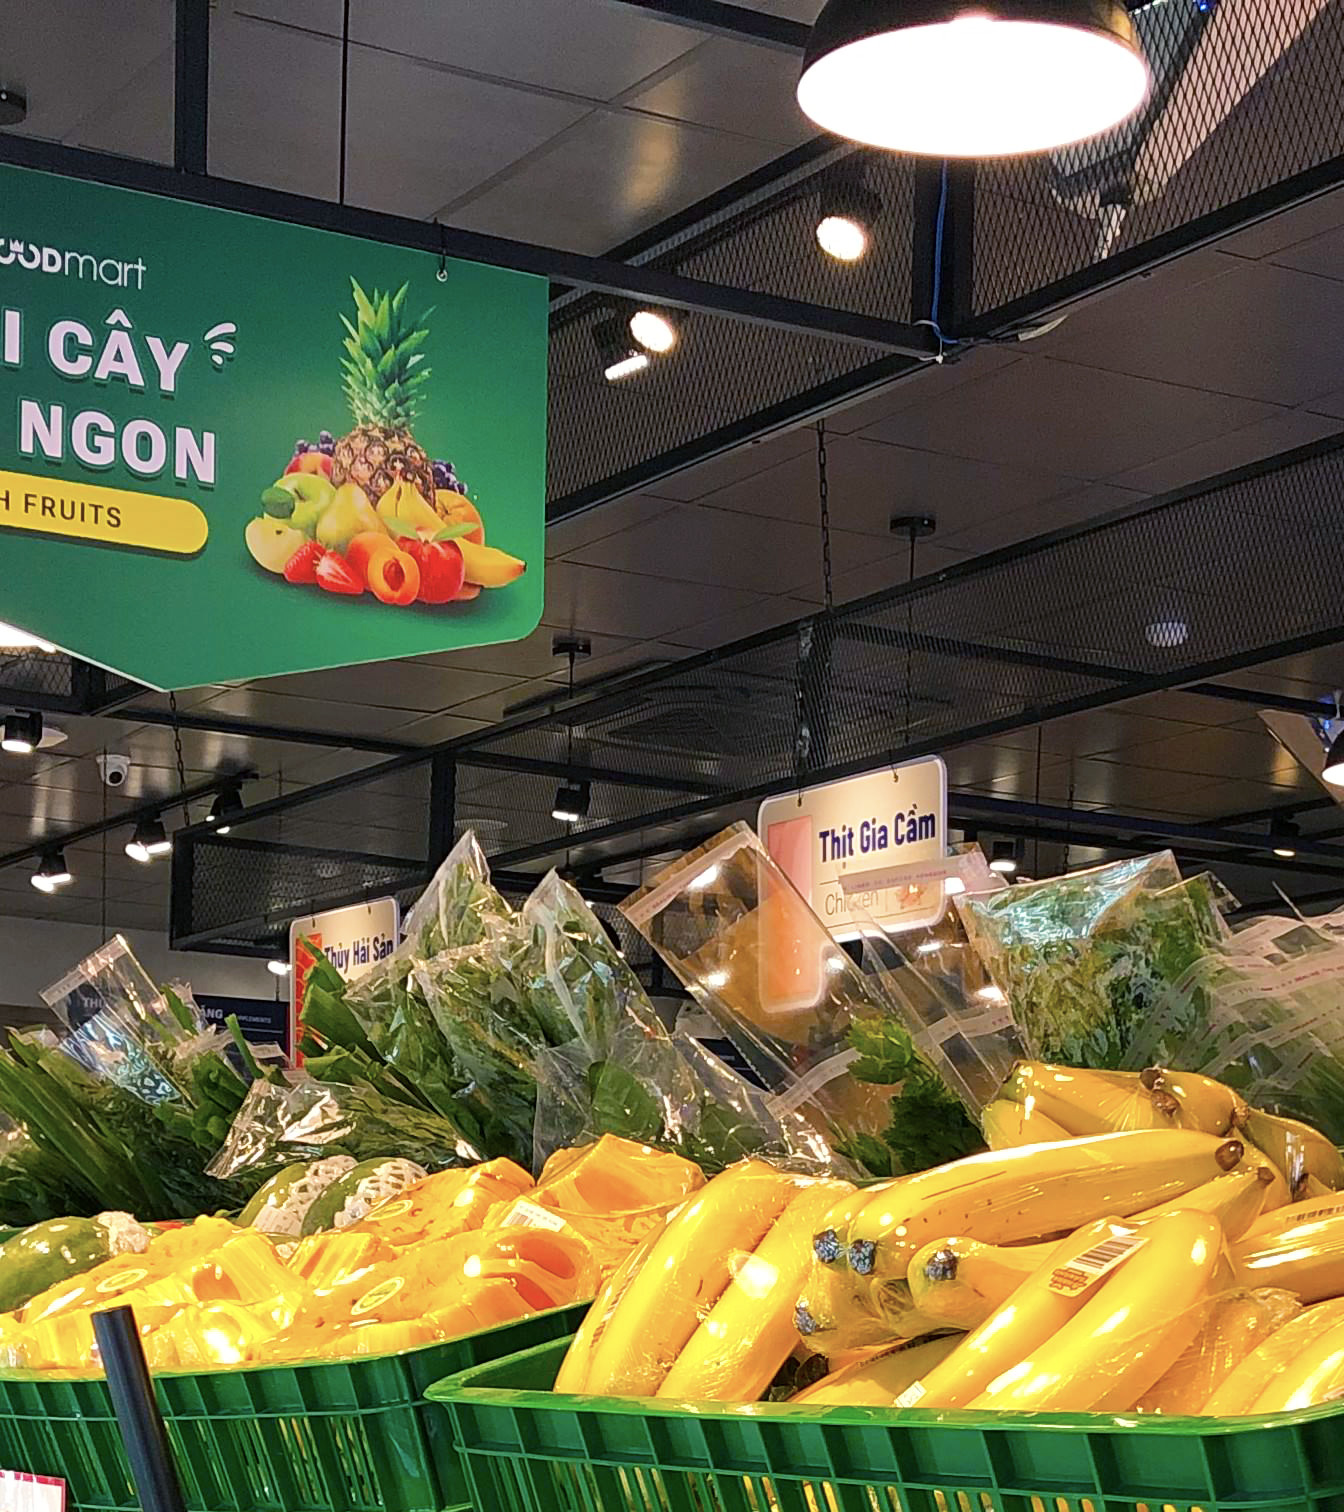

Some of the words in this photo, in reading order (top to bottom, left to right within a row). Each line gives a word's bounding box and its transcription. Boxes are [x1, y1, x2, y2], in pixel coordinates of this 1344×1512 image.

[46, 307, 192, 394] CÂY
[18, 398, 218, 486] NGON
[23, 491, 123, 531] FRUITS
[819, 824, 854, 869] Thịt
[859, 817, 888, 854] Gia
[894, 803, 936, 846] Cầm
[825, 889, 879, 916] Chien
[323, 941, 350, 975] Thủy
[353, 937, 370, 966] Hải
[373, 932, 394, 961] Sản
